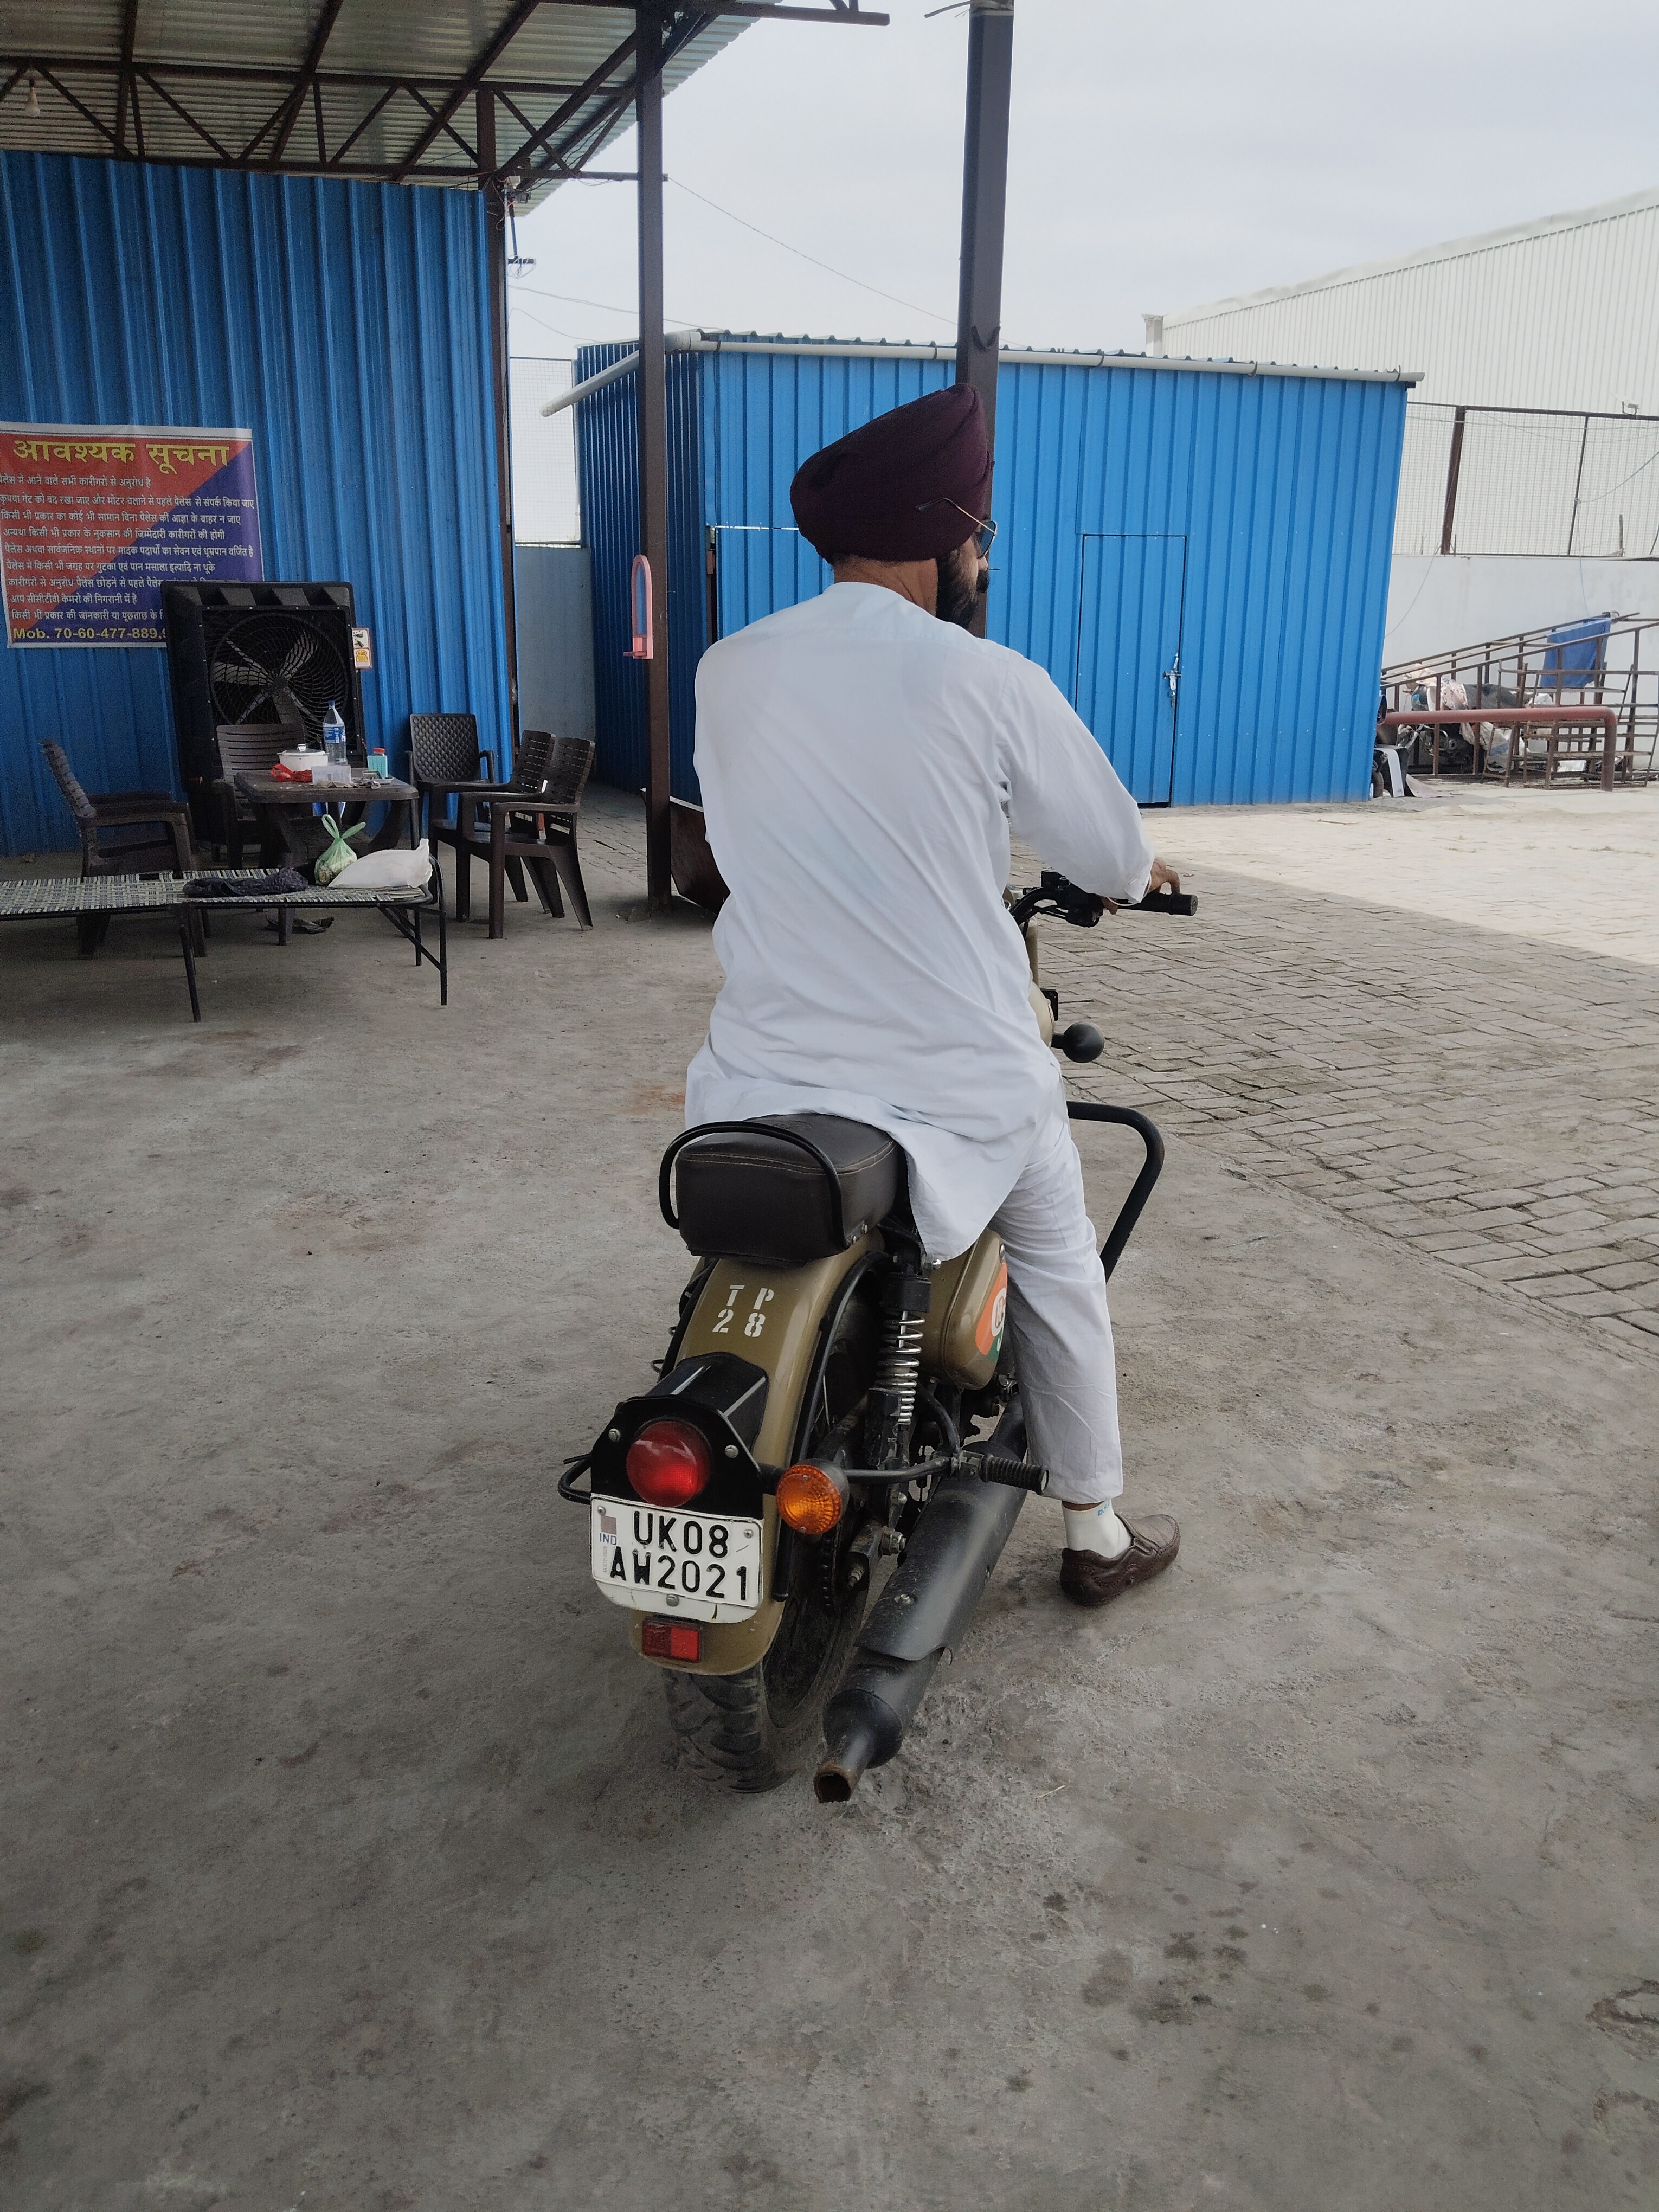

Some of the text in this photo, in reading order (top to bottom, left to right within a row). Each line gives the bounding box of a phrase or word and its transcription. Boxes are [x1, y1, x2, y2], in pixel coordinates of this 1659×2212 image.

[13, 440, 229, 474] आवश्यक सूचना
[27, 473, 42, 485] आने
[44, 474, 59, 485] वाले
[61, 475, 76, 486] सभी
[79, 475, 107, 486] कारीगरों
[110, 475, 117, 486] से
[120, 476, 143, 488] अनुरोध
[146, 477, 151, 488] है
[0, 494, 20, 505] कृपया
[22, 492, 33, 503] गेट
[35, 493, 44, 504] को
[59, 495, 73, 504] रखा
[76, 496, 90, 505] जाए
[92, 493, 105, 505] और
[107, 494, 124, 505] मोटर
[126, 494, 146, 506] चलाने
[148, 494, 155, 506] से
[156, 495, 172, 506] पहले
[175, 496, 191, 506] पैलेस
[195, 496, 201, 507] से
[203, 496, 221, 507] संपर्क
[222, 497, 240, 508] किया
[242, 499, 254, 509] जाए
[1, 509, 20, 520] किसी
[23, 510, 31, 520] भी
[35, 512, 53, 520] प्रकार
[56, 512, 66, 520] का
[69, 510, 83, 522] कोई
[86, 510, 95, 521] भी
[98, 513, 119, 522] सामान
[140, 511, 157, 522] पैलेस
[159, 511, 169, 522] की
[172, 514, 188, 524] आज्ञा
[191, 512, 198, 523] के
[227, 516, 241, 524] जाए
[3, 526, 225, 540] अन्यथा किसी भी प्रकार के नुकसान की जिम्मेदारी कारीगरों की होगी
[5, 543, 22, 554] पैलेस
[25, 545, 44, 554] अथवा
[47, 543, 82, 554] सार्वजनिक
[85, 543, 104, 554] स्थानों
[118, 546, 138, 555] मादक
[140, 544, 160, 555] पदार्थों
[162, 546, 171, 555] का
[173, 544, 190, 555] सेवन
[191, 545, 201, 557] एवं
[204, 547, 227, 557] धूम्रपान
[229, 545, 247, 556] वर्जित
[249, 545, 253, 557] है
[7, 558, 24, 570] पैलेस
[34, 559, 53, 570] किसी
[55, 560, 64, 570] भी
[66, 563, 82, 571] जगह
[97, 563, 115, 573] गुटका
[118, 561, 128, 571] एवं
[130, 563, 143, 571] पान
[145, 563, 168, 571] मसाला
[170, 561, 191, 573] इत्यादि
[8, 576, 37, 587] कारीगरों
[39, 576, 46, 587] से
[49, 576, 73, 589] अनुरोध
[76, 576, 94, 587] पैलेस
[97, 576, 117, 589] छोड़ने
[119, 576, 126, 587] से
[128, 577, 144, 588] पहले
[27, 593, 59, 603] सीसीटीवी
[83, 593, 93, 603] की
[94, 593, 123, 604] निगरानी
[132, 592, 137, 604] है
[11, 609, 30, 620] किसी
[33, 609, 41, 620] भी
[44, 611, 63, 620] प्रकार
[66, 609, 76, 620] की
[78, 609, 109, 620] जानकारी
[112, 612, 119, 620] या
[121, 612, 147, 622] पूछताछ
[150, 609, 157, 620] के
[14, 628, 49, 639] Mob.
[599, 1533, 616, 1545] IND
[634, 1510, 729, 1558] UK08
[610, 1546, 747, 1600] AW2021
